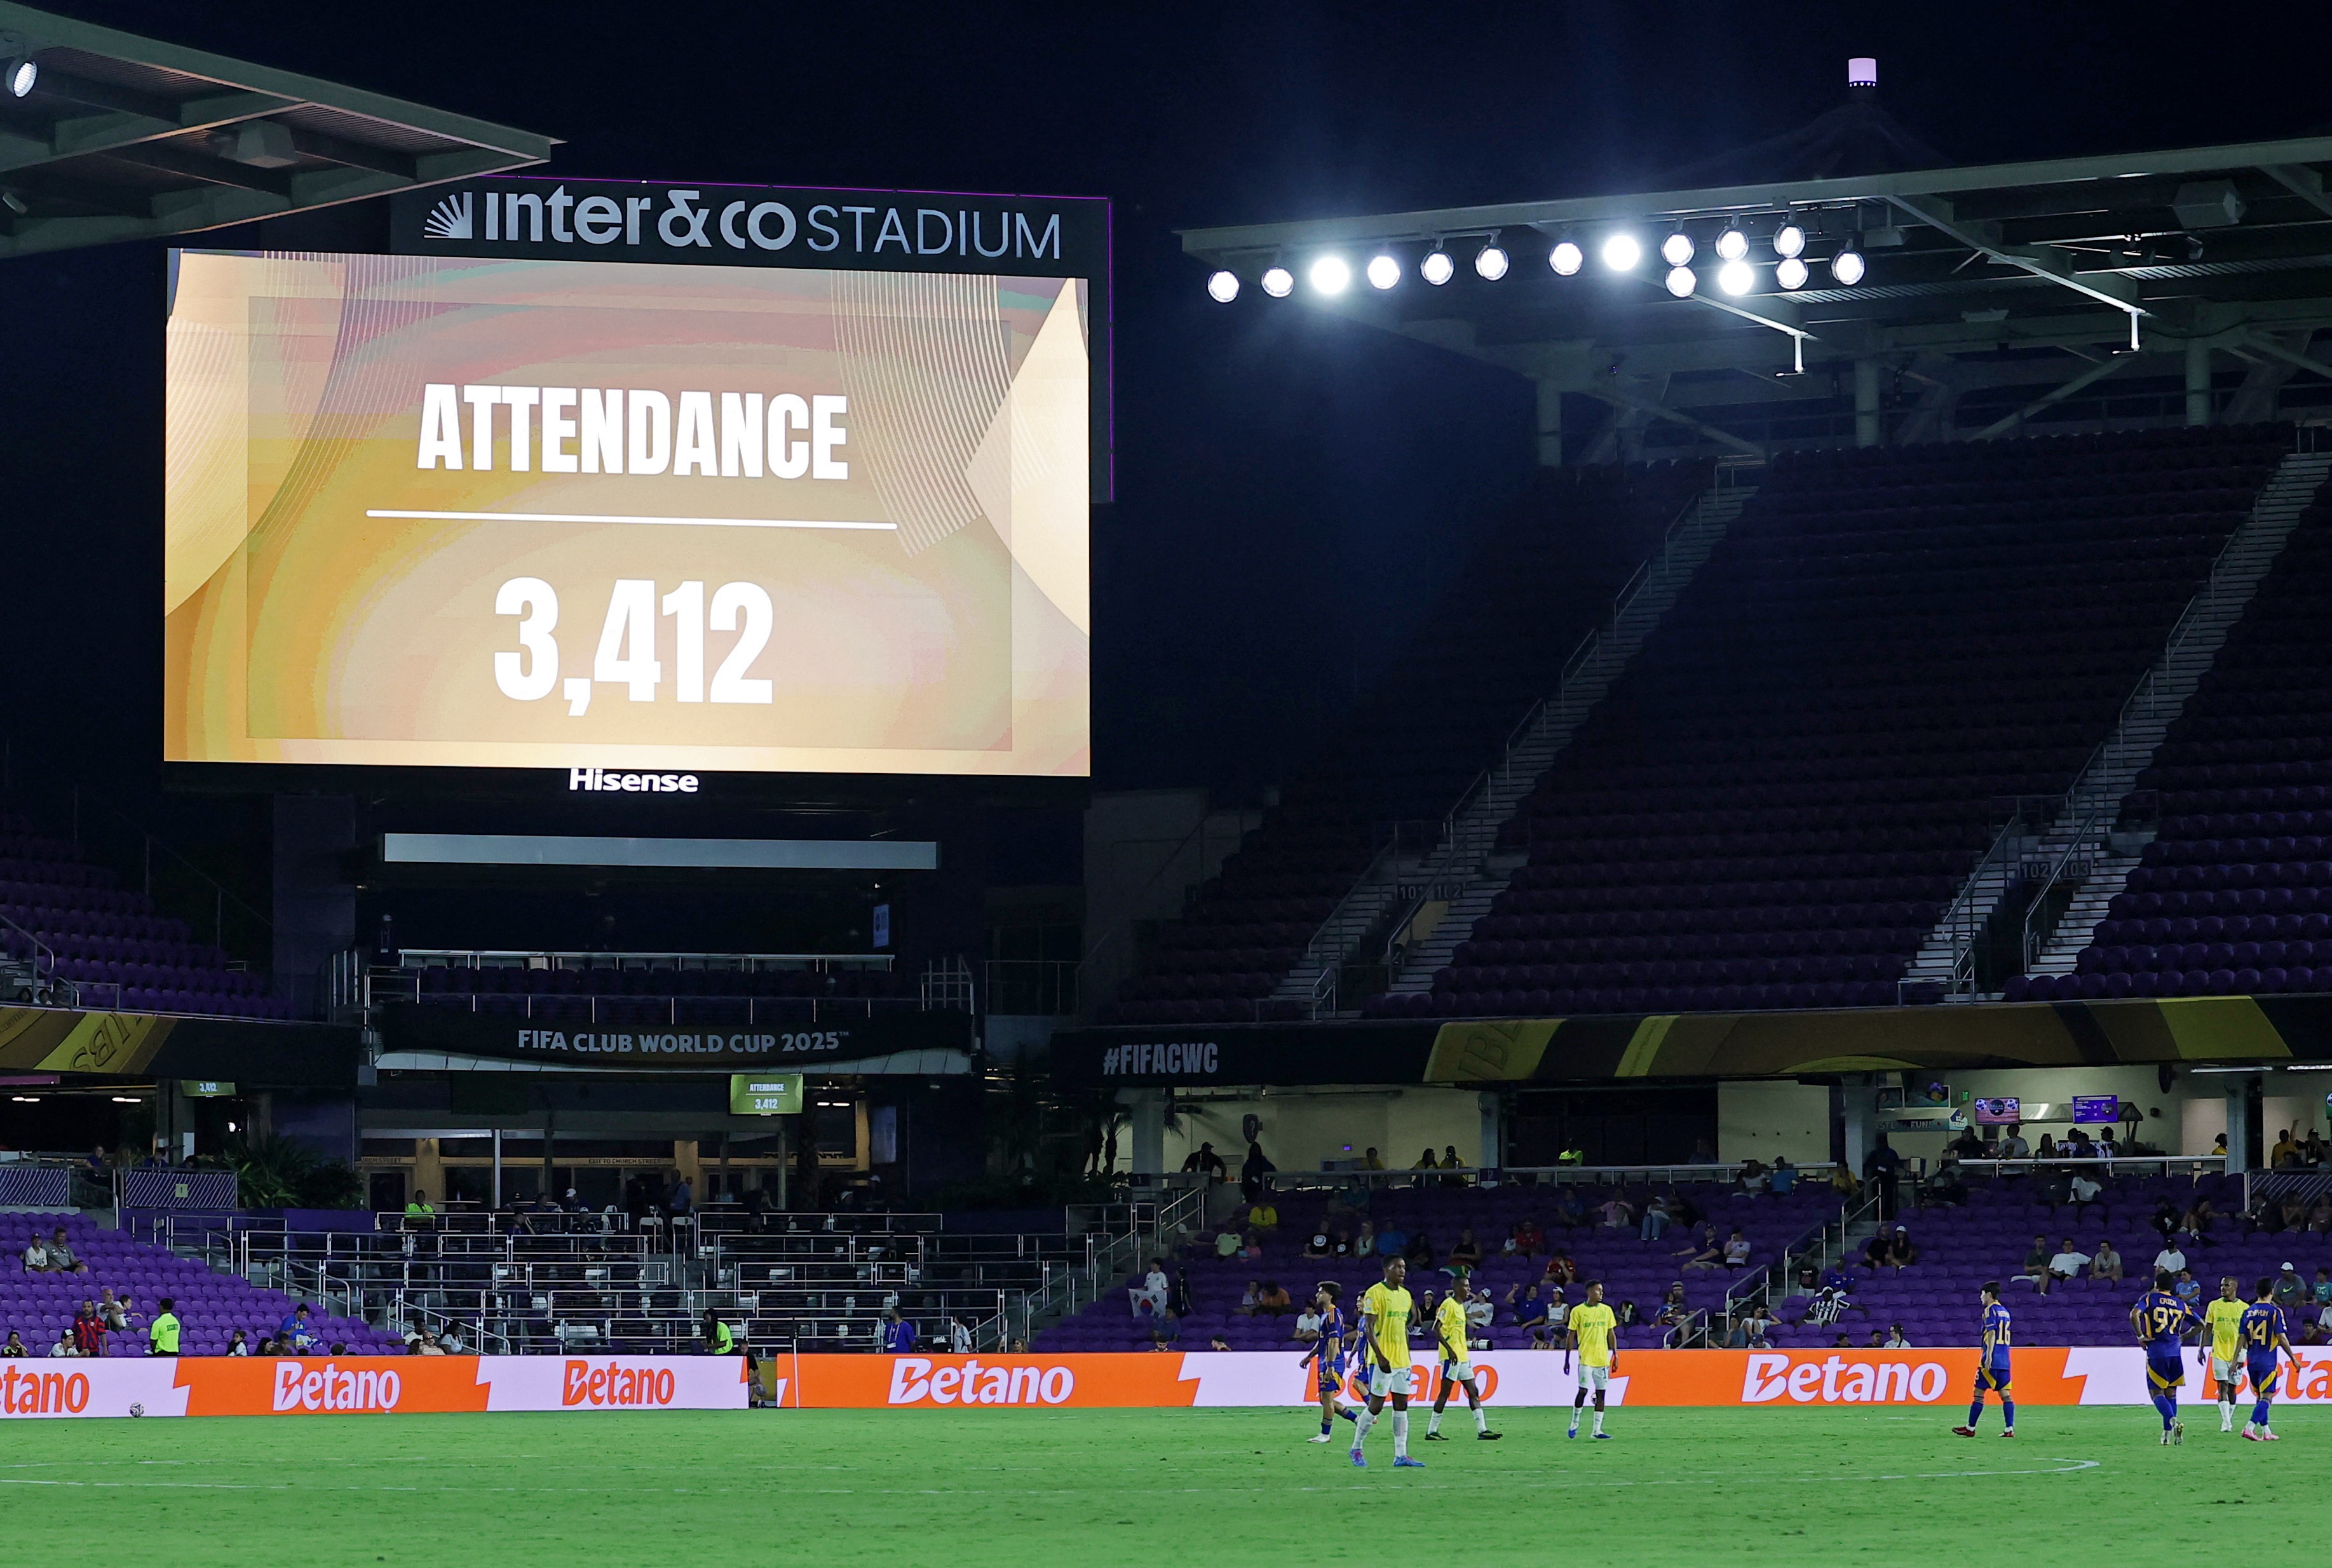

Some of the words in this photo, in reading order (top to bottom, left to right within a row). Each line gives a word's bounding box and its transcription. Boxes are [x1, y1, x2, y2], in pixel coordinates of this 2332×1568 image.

[806, 205, 1061, 259] STADIUM
[417, 383, 850, 481] ATTENDANCE
[494, 576, 774, 717] 3,412
[569, 767, 700, 793] Hisense
[518, 1029, 569, 1051] FIFA
[573, 1032, 634, 1053] CLUB
[639, 1034, 724, 1053] WORLD
[729, 1034, 776, 1053] CUP
[1103, 1043, 1218, 1075] #FIFACWC
[199, 1083, 218, 1093] 3,412
[749, 1083, 785, 1092] ATTENDANCE
[754, 1098, 778, 1110] 3,412
[1910, 1120, 1932, 1129] FUN!
[1996, 1319, 2011, 1346] 16
[2153, 1306, 2183, 1334] 97
[2246, 1320, 2267, 1346] 14
[0, 1365, 90, 1414] tano
[273, 1361, 401, 1412] Betano
[562, 1360, 675, 1406] Betano
[888, 1358, 1074, 1404] Betano
[1741, 1353, 1947, 1403] Betano
